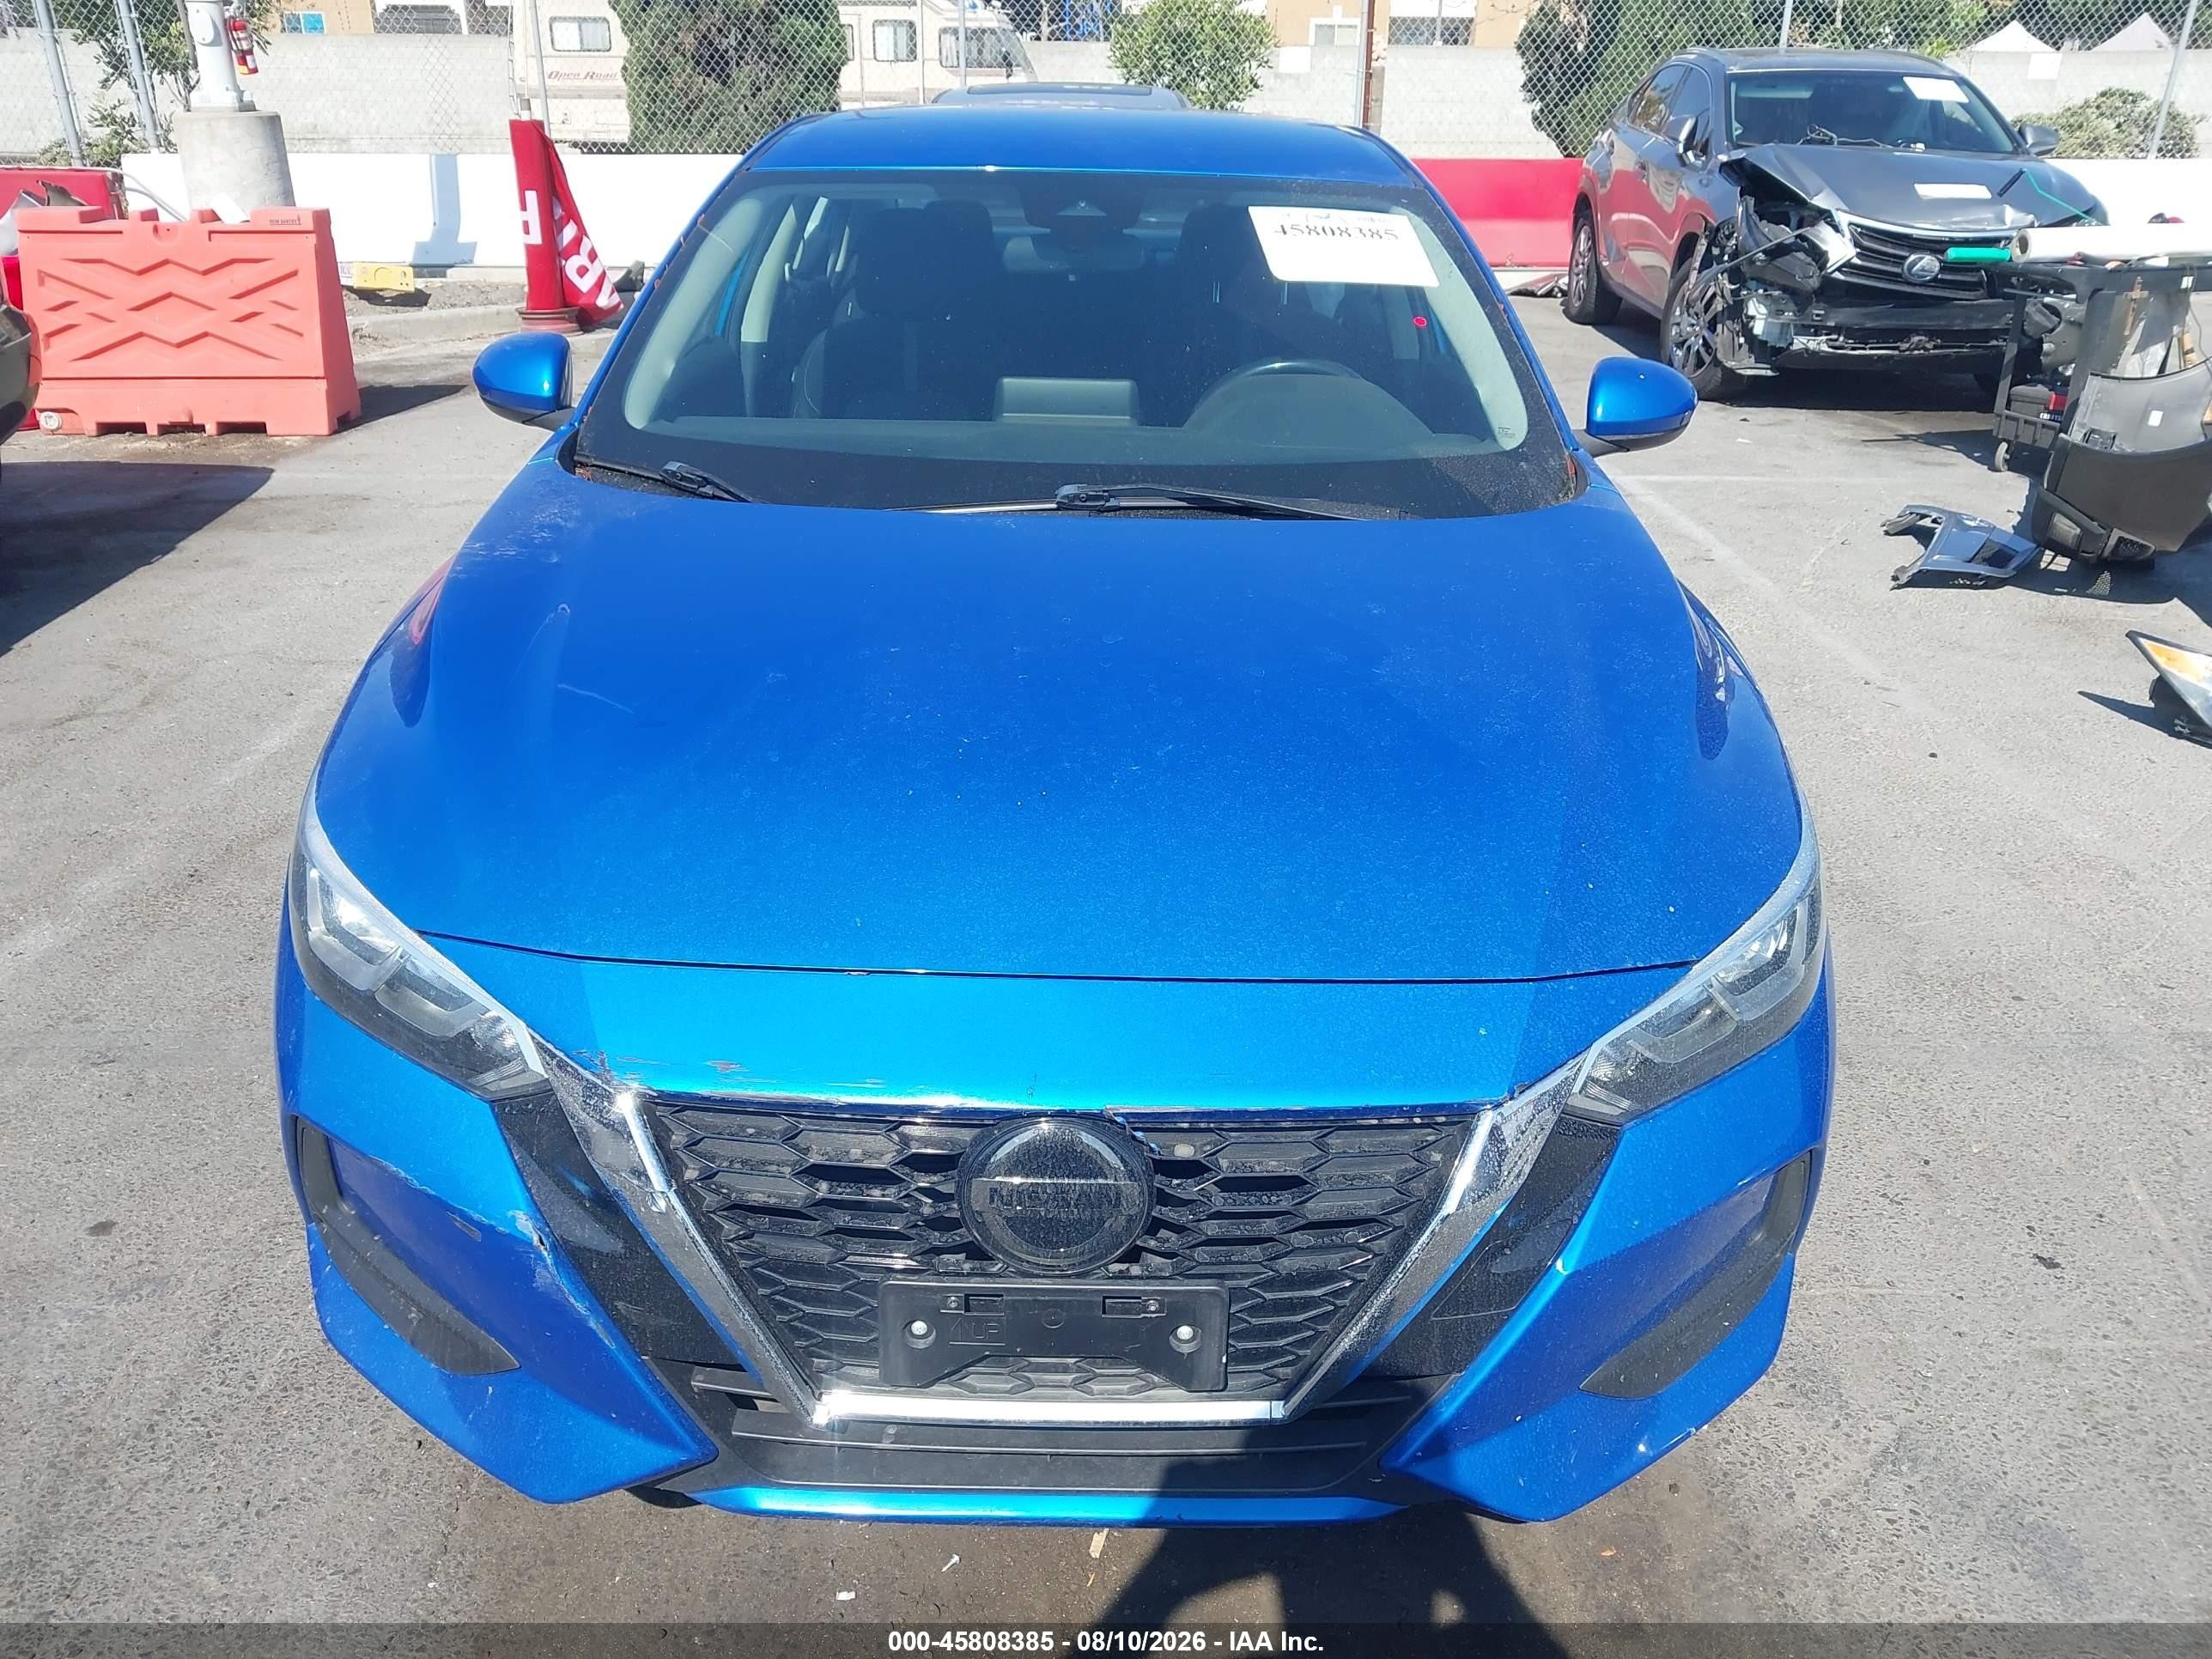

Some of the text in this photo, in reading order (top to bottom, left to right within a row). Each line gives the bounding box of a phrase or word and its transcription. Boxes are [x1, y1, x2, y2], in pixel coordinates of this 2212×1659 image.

[548, 70, 618, 82] Open Road
[1274, 223, 1398, 240] 45808385
